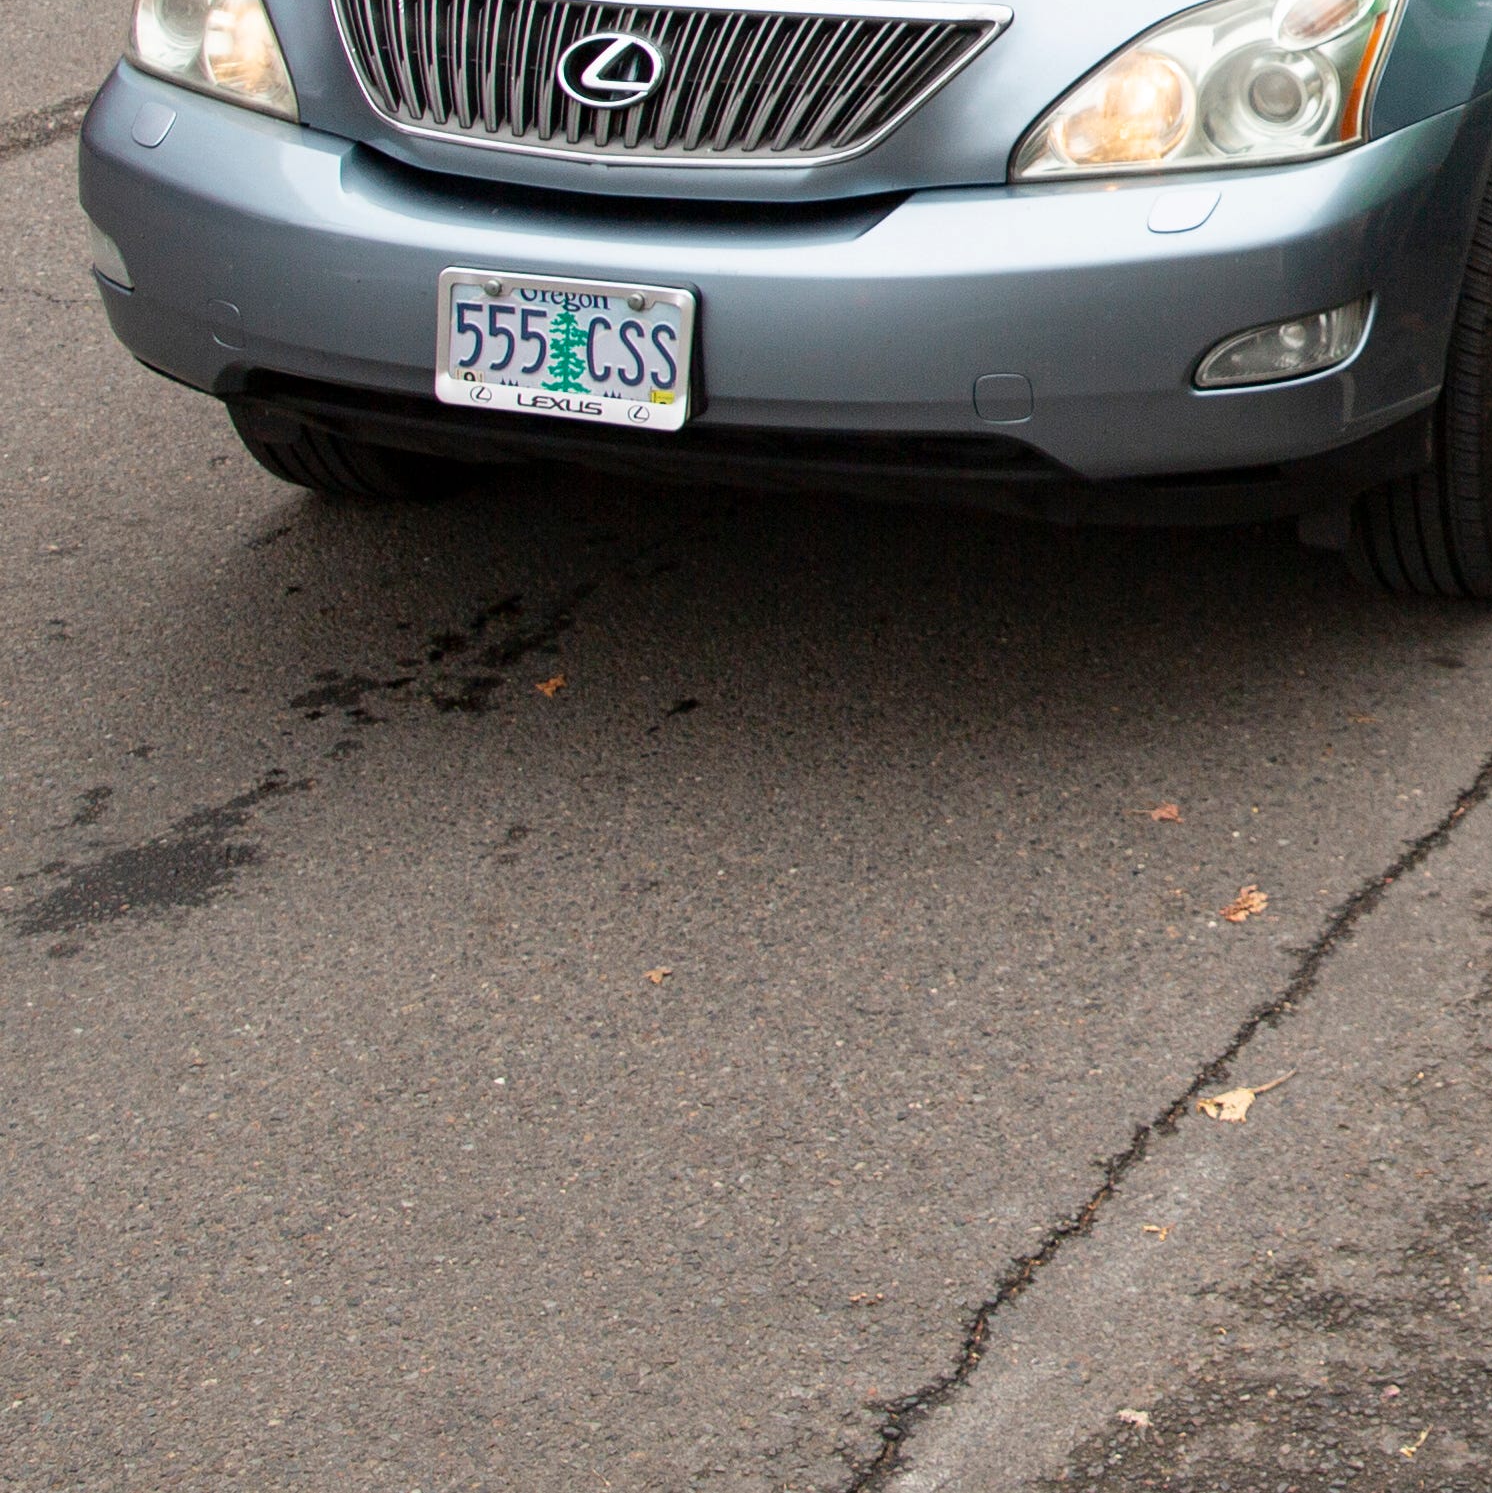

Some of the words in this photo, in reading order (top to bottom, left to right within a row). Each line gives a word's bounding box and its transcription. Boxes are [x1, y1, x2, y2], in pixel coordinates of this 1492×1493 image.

[456, 302, 548, 375] 555
[586, 315, 677, 390] CSS
[517, 392, 602, 416] LEXUS
